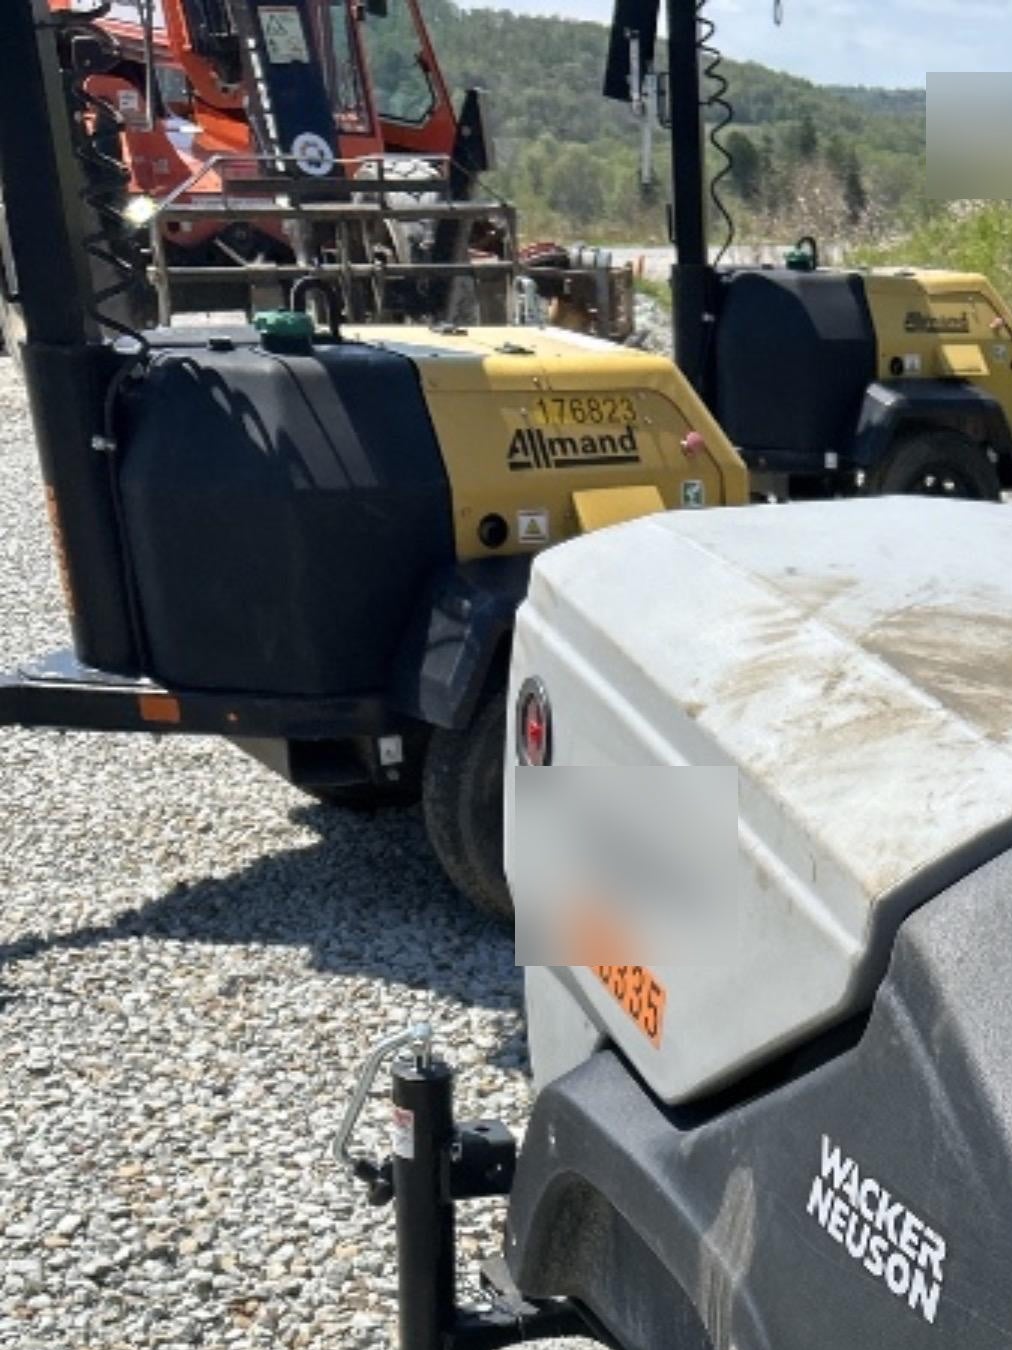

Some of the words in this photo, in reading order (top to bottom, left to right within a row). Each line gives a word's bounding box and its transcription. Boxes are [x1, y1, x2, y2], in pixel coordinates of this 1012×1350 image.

[507, 425, 641, 470] Allmand
[537, 397, 637, 424] 176823
[806, 1175, 941, 1324] NEUSON
[821, 1133, 946, 1282] WACKER
